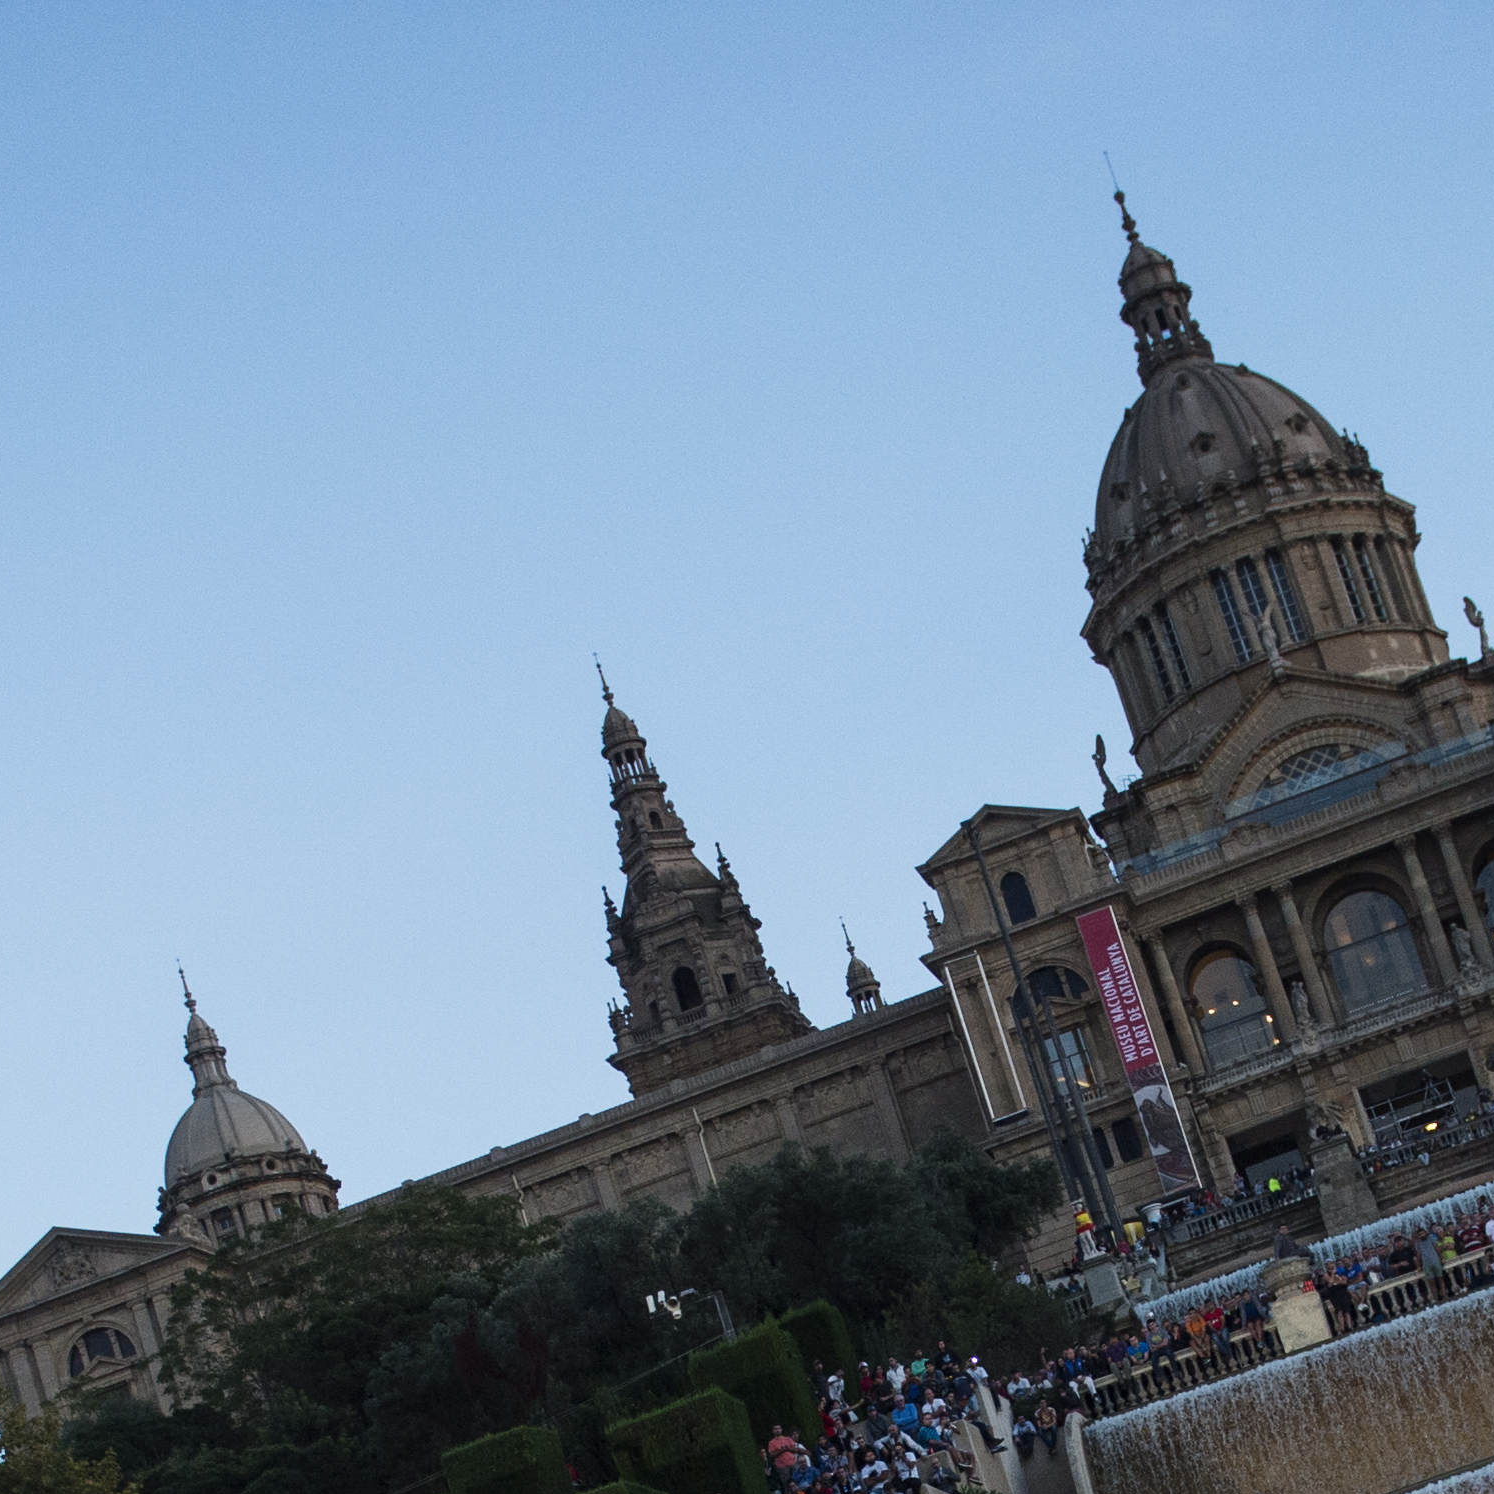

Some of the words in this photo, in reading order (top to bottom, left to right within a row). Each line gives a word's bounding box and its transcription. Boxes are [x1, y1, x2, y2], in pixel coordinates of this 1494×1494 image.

[1107, 942, 1136, 1004] CATALUNYA
[1097, 967, 1126, 1022] NACIONAL
[1127, 1006, 1143, 1022] DE
[1116, 1023, 1138, 1062] MUSEU
[1132, 1024, 1154, 1057] D'ART
